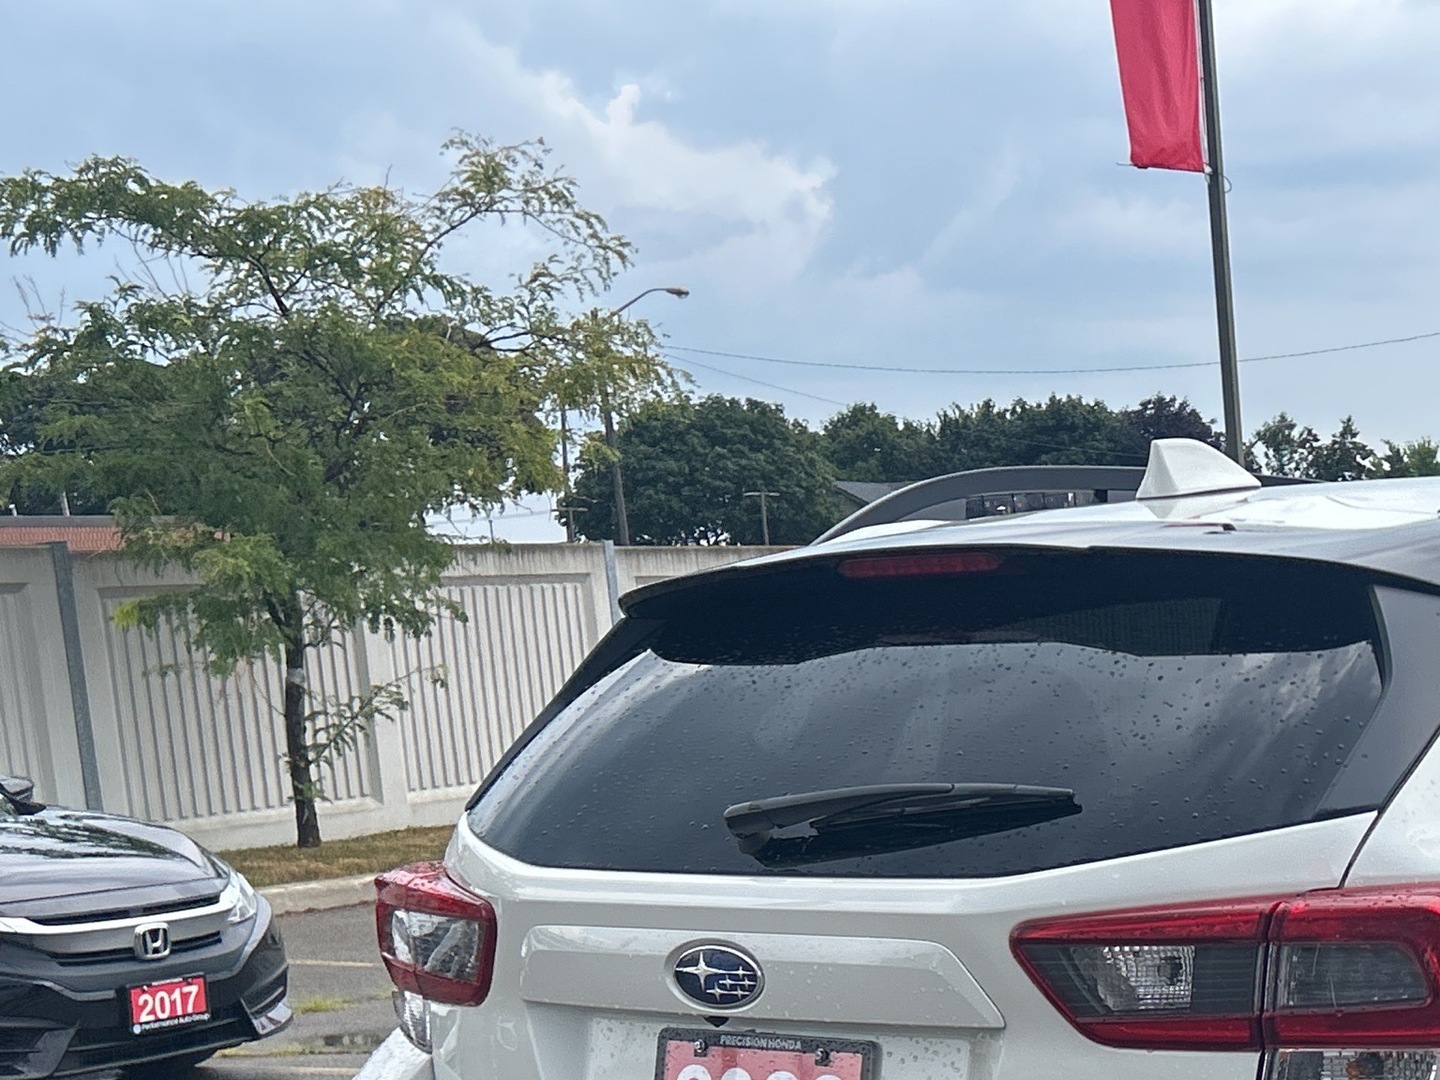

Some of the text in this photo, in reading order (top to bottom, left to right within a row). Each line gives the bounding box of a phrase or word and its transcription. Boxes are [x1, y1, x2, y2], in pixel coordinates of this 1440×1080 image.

[138, 985, 199, 1022] 2017
[719, 1034, 802, 1051] PRECISION HONDA
